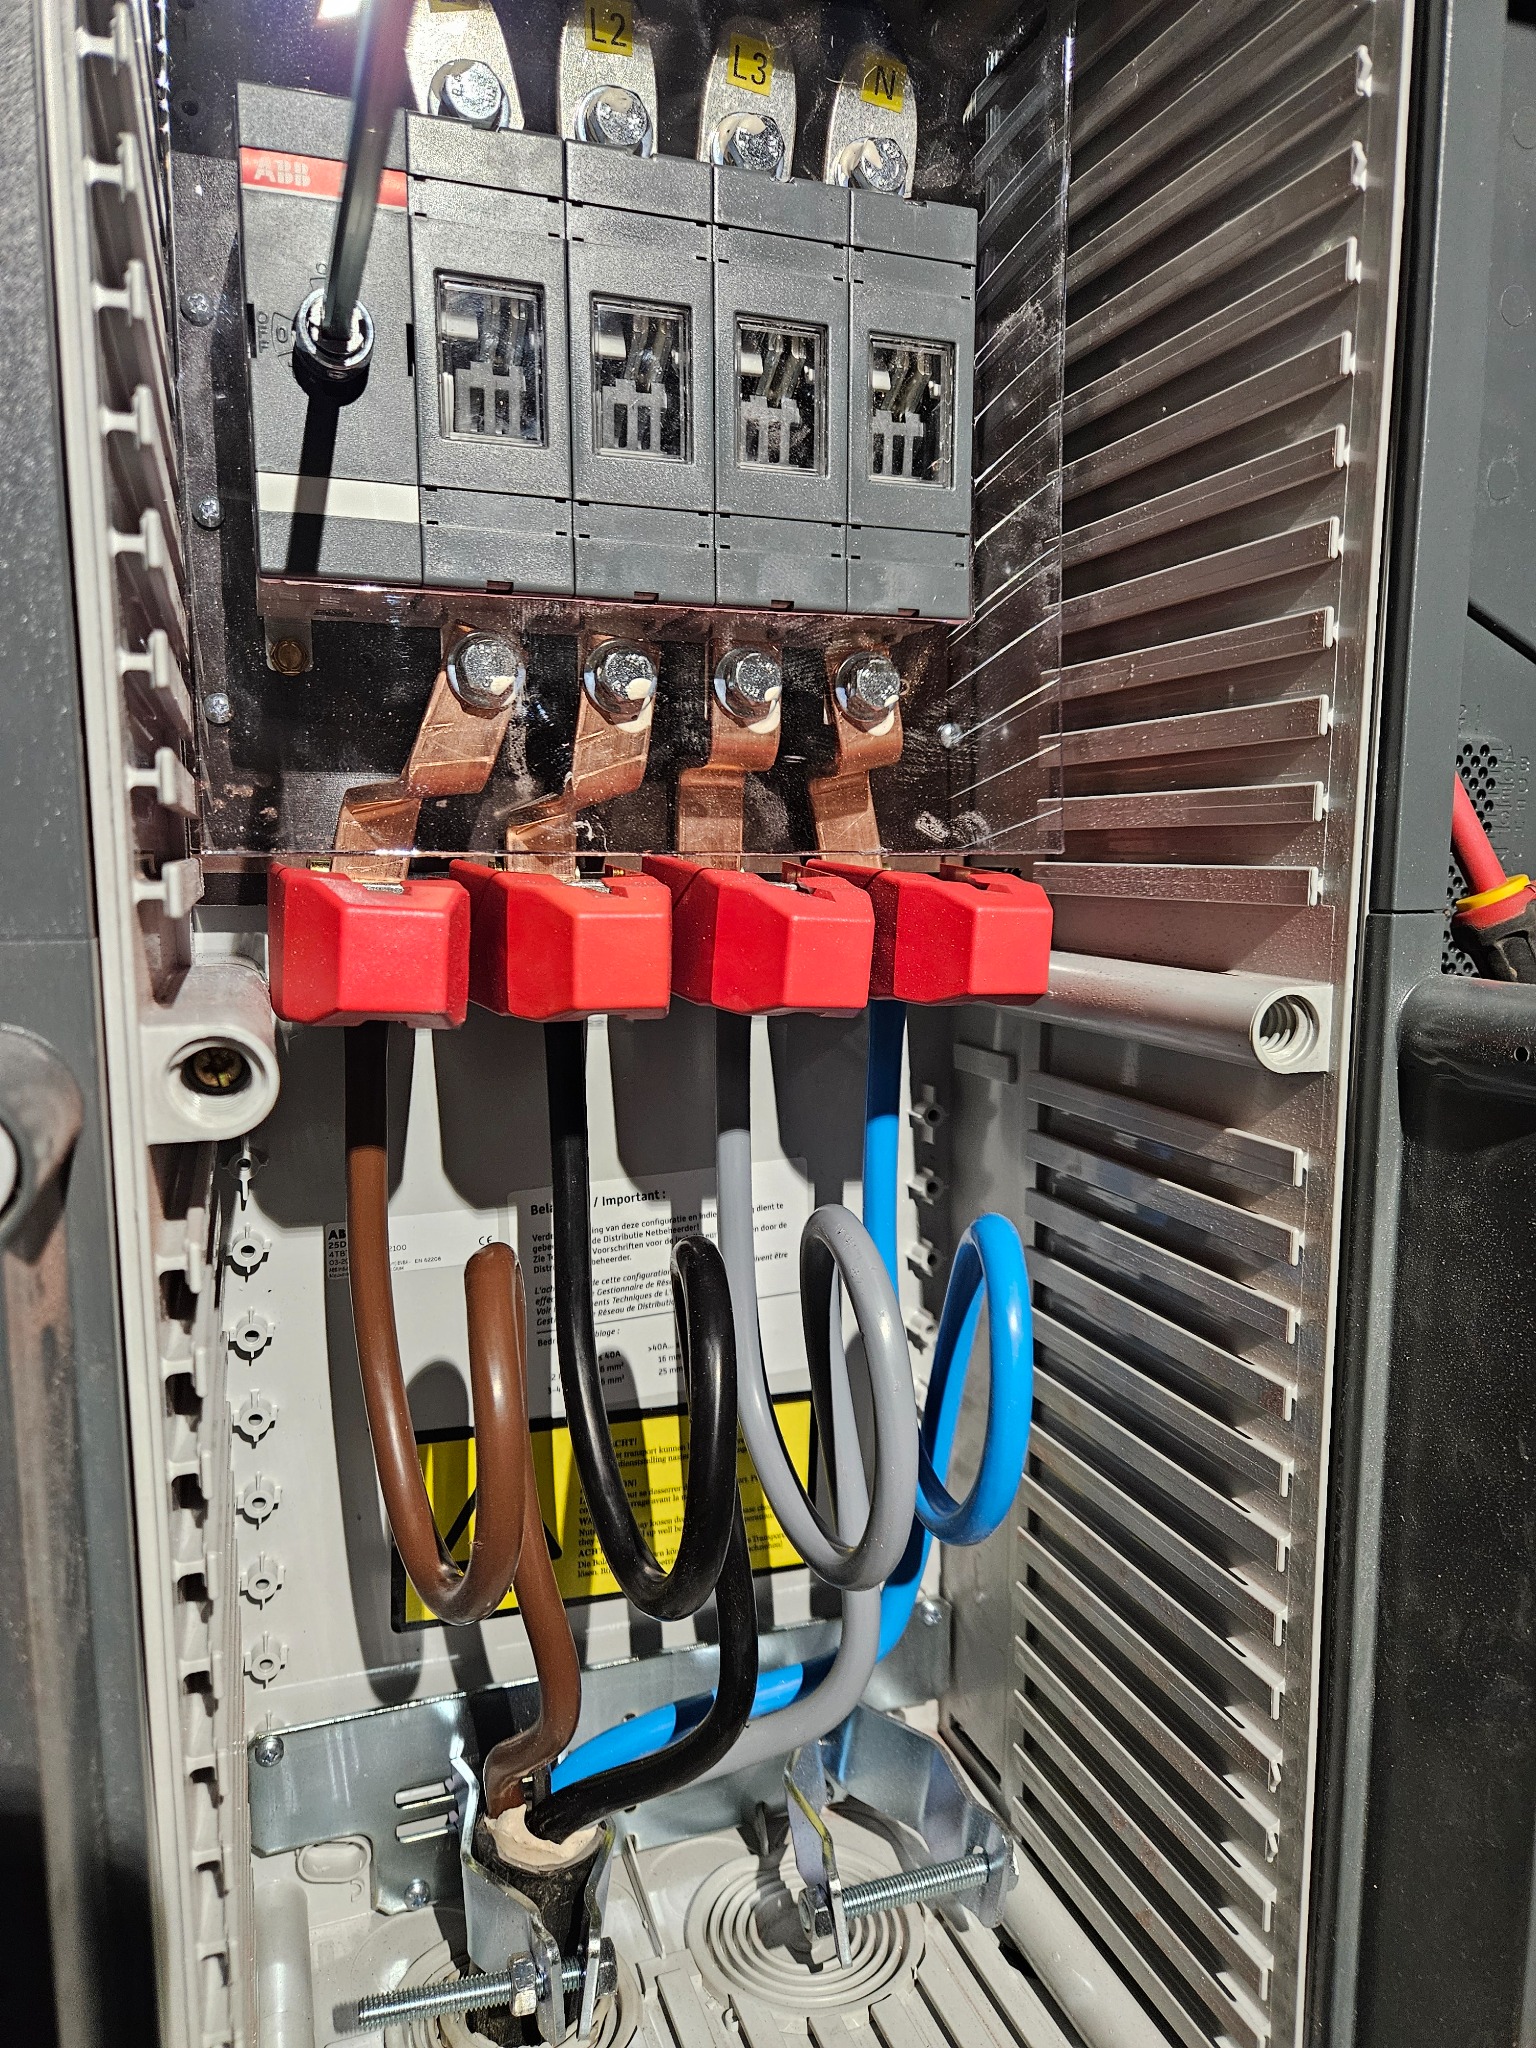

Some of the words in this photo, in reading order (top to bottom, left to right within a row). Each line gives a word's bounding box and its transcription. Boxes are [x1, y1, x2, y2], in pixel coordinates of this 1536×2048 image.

[590, 7, 627, 47] L2
[733, 44, 768, 85] L3
[874, 65, 896, 101] N
[254, 157, 311, 187] ABB
[602, 1190, 660, 1207] Important
[621, 1222, 640, 1230] deze
[641, 1213, 687, 1228] configuratie
[688, 1214, 698, 1222] en
[756, 1204, 775, 1212] dient
[533, 1255, 546, 1264] Zie
[592, 1242, 644, 1255] Voorschriften
[645, 1240, 662, 1248] voor
[778, 1221, 788, 1229] de
[603, 1231, 644, 1243] Distributie
[645, 1223, 700, 1237] Netbeheerder!
[597, 1283, 644, 1297] Gestionnaire
[645, 1281, 655, 1290] de
[601, 1275, 621, 1286] cette
[612, 1292, 653, 1305] Techniques
[653, 1290, 664, 1298] de
[598, 1307, 625, 1317] Réseau
[626, 1304, 636, 1312] de
